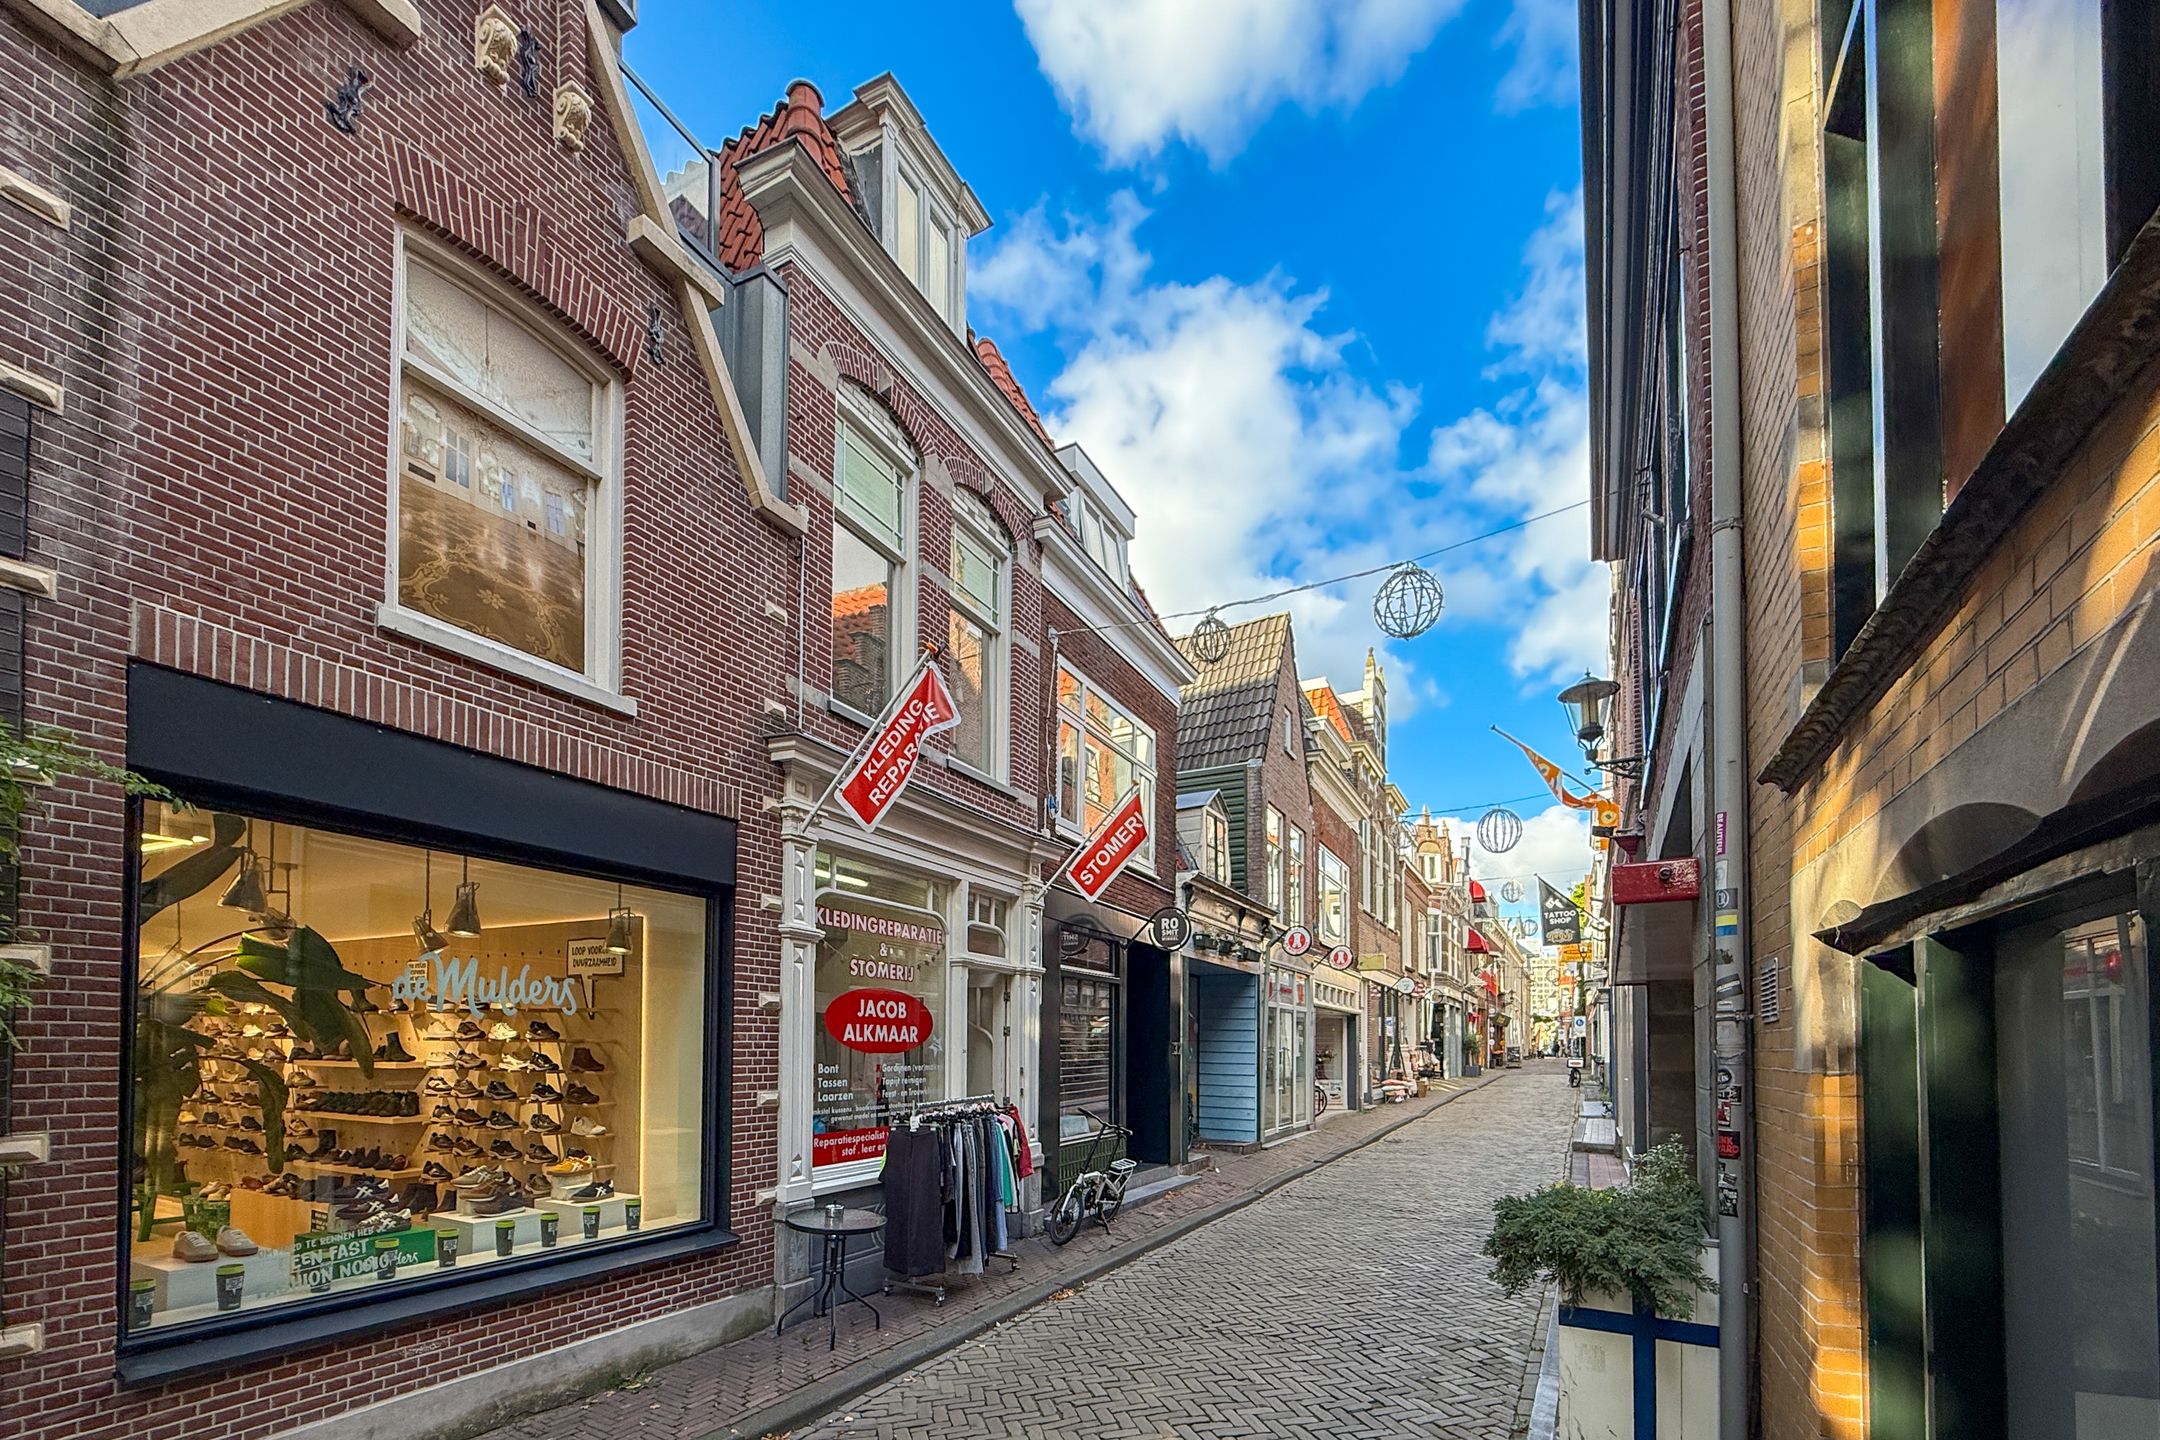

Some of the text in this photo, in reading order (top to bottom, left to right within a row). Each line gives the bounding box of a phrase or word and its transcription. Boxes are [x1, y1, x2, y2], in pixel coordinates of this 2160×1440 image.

[863, 699, 923, 782] KLEDING
[1543, 910, 1576, 919] TATTOO
[1549, 917, 1571, 925] SHOP
[815, 905, 944, 944] KLEDINGREPARATIE
[1161, 917, 1179, 929] RO
[571, 946, 586, 955] LOOP
[879, 942, 889, 957] &
[572, 956, 617, 967] DUURZAAMHEID
[850, 958, 915, 983] STOMERIJ
[392, 965, 432, 1000] de
[419, 952, 576, 1019] Mulders
[857, 999, 907, 1020] JACOB
[843, 1023, 918, 1044] ALKMAAR
[817, 1063, 839, 1075] Bont
[817, 1077, 847, 1089] Tassen
[882, 1076, 927, 1088] Tapijt reinigen
[817, 1091, 854, 1103] Laarzen
[882, 1090, 897, 1099] Feest
[814, 1130, 885, 1150] Reparatiespecialist
[842, 1147, 857, 1158] stof
[861, 1144, 876, 1155] leer
[877, 1143, 886, 1152] en
[306, 1239, 317, 1249] TE
[319, 1228, 356, 1245] RENNEN
[357, 1228, 374, 1238] HEB
[329, 1238, 370, 1264] FAST
